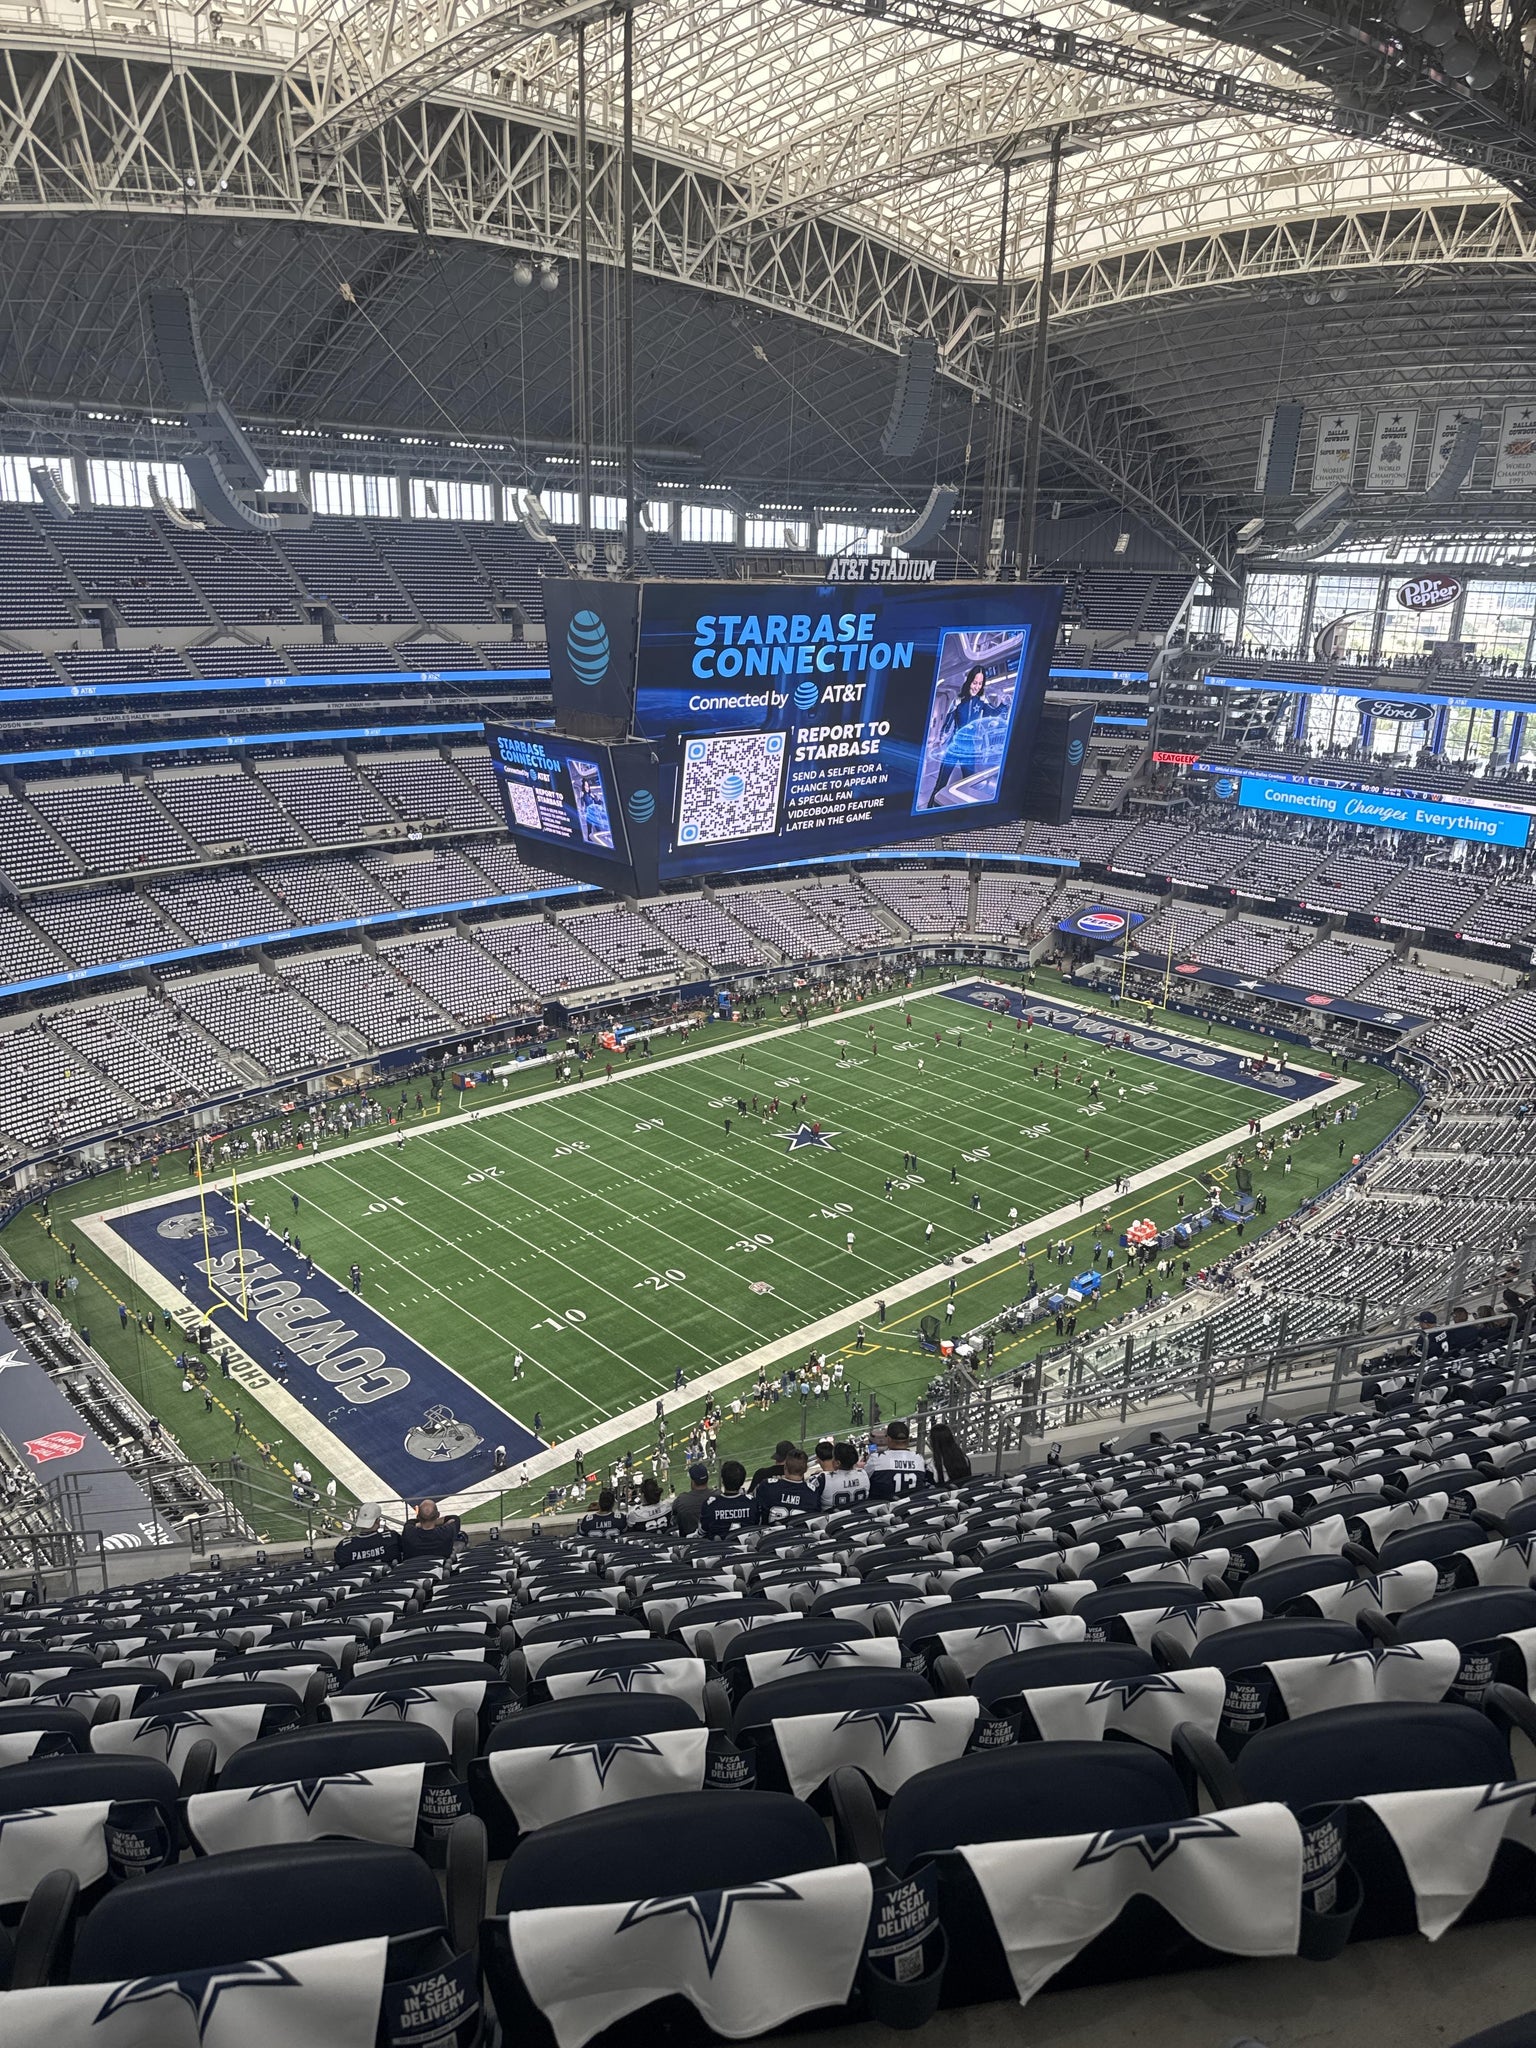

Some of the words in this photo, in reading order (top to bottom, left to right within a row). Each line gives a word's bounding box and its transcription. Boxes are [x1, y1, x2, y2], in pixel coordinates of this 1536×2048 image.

[827, 559, 868, 580] AT&T
[869, 560, 937, 581] STADIUM
[1419, 579, 1441, 593] Dr
[1404, 583, 1457, 607] Pepper
[694, 613, 876, 646] STARBASE
[691, 642, 914, 679] CONNECTION
[688, 691, 769, 711] Connected
[770, 690, 790, 709] by
[821, 683, 867, 703] AT&T
[1371, 701, 1418, 719] Ford
[797, 723, 865, 743] REPORT
[868, 721, 891, 737] TO
[497, 736, 546, 757] STARBASE
[794, 739, 881, 762] STARBASE
[500, 749, 561, 772] CONNECTION
[1158, 752, 1195, 763] SEATGEEK
[792, 770, 817, 782] SEND
[818, 770, 826, 779] A
[827, 766, 856, 778] SELFIE
[857, 764, 875, 774] FOR
[875, 763, 883, 772] A
[790, 782, 828, 794] CHANCE
[830, 780, 842, 789] TO
[843, 775, 878, 788] APPEAR
[878, 774, 888, 782] IN
[788, 798, 796, 807] A
[797, 793, 834, 806] SPECIAL
[835, 790, 853, 800] FAN
[1264, 788, 1337, 812] Connecting
[1344, 798, 1408, 821] Changes
[788, 803, 847, 820] VIDEOBOARD
[847, 798, 885, 811] FEATURE
[786, 819, 814, 832] LATER
[815, 818, 825, 828] IN
[827, 816, 845, 826] THE
[846, 811, 873, 823] GAME.
[1171, 878, 1209, 890] Blockchain.com
[1235, 889, 1276, 903] Blockchain.com
[1306, 903, 1349, 917] Blockchain.com
[1083, 916, 1119, 928] PEPSI
[1380, 917, 1426, 932] Blockchain.com
[1462, 934, 1511, 950] Blockchain.com
[118, 959, 145, 969] Connecting
[74, 970, 87, 979] AT&T
[1021, 1005, 1228, 1067] COWBOYS
[892, 1040, 918, 1051] 20
[774, 1076, 801, 1088] 40
[1131, 1082, 1160, 1096] 10
[707, 1096, 738, 1109] 50
[1076, 1101, 1107, 1118] 20
[635, 1118, 665, 1131] 40
[1019, 1123, 1051, 1139] 30
[555, 1141, 591, 1155] 30
[961, 1147, 991, 1165] 40
[467, 1166, 506, 1182] 20
[891, 1174, 926, 1191] 50
[368, 1195, 409, 1213] 10
[819, 1201, 855, 1221] 40
[735, 1233, 775, 1253] 30
[643, 1268, 687, 1291] 20
[193, 1249, 411, 1404] COWBOYS
[543, 1308, 588, 1333] 10
[894, 1459, 916, 1470] DOWNS
[843, 1478, 860, 1489] LAMB
[781, 1493, 800, 1505] LAMB
[715, 1507, 751, 1520] PRESCOTT
[595, 1520, 612, 1529] LAMB
[351, 1545, 386, 1561] PARSONS
[1230, 1691, 1260, 1702] IN-SEAT
[1235, 1685, 1256, 1693] VISA
[1224, 1698, 1262, 1710] DELIVERY
[983, 1725, 1013, 1737] IN-SEAT
[988, 1720, 1008, 1729] VISA
[978, 1731, 1015, 1745] DELIVERY
[714, 1760, 746, 1771] IN-SEAT
[718, 1755, 740, 1763] VISA
[711, 1767, 749, 1779] DELIVERY
[424, 1795, 458, 1806] IN-SEAT
[428, 1788, 452, 1797] VISA
[422, 1801, 462, 1814] DELIVERY
[115, 1831, 138, 1841] VISA
[1307, 1821, 1333, 1842] VISA
[111, 1843, 151, 1857] DELIVERY
[112, 1837, 145, 1848] IN-SEAT
[885, 1881, 918, 1903] VISA
[881, 1889, 925, 1922] IN-SEAT
[877, 1901, 930, 1939] DELIVERY
[407, 1973, 447, 1995] VISA
[403, 1979, 457, 2013] IN-SEAT
[400, 1989, 465, 2029] DELIVERY
